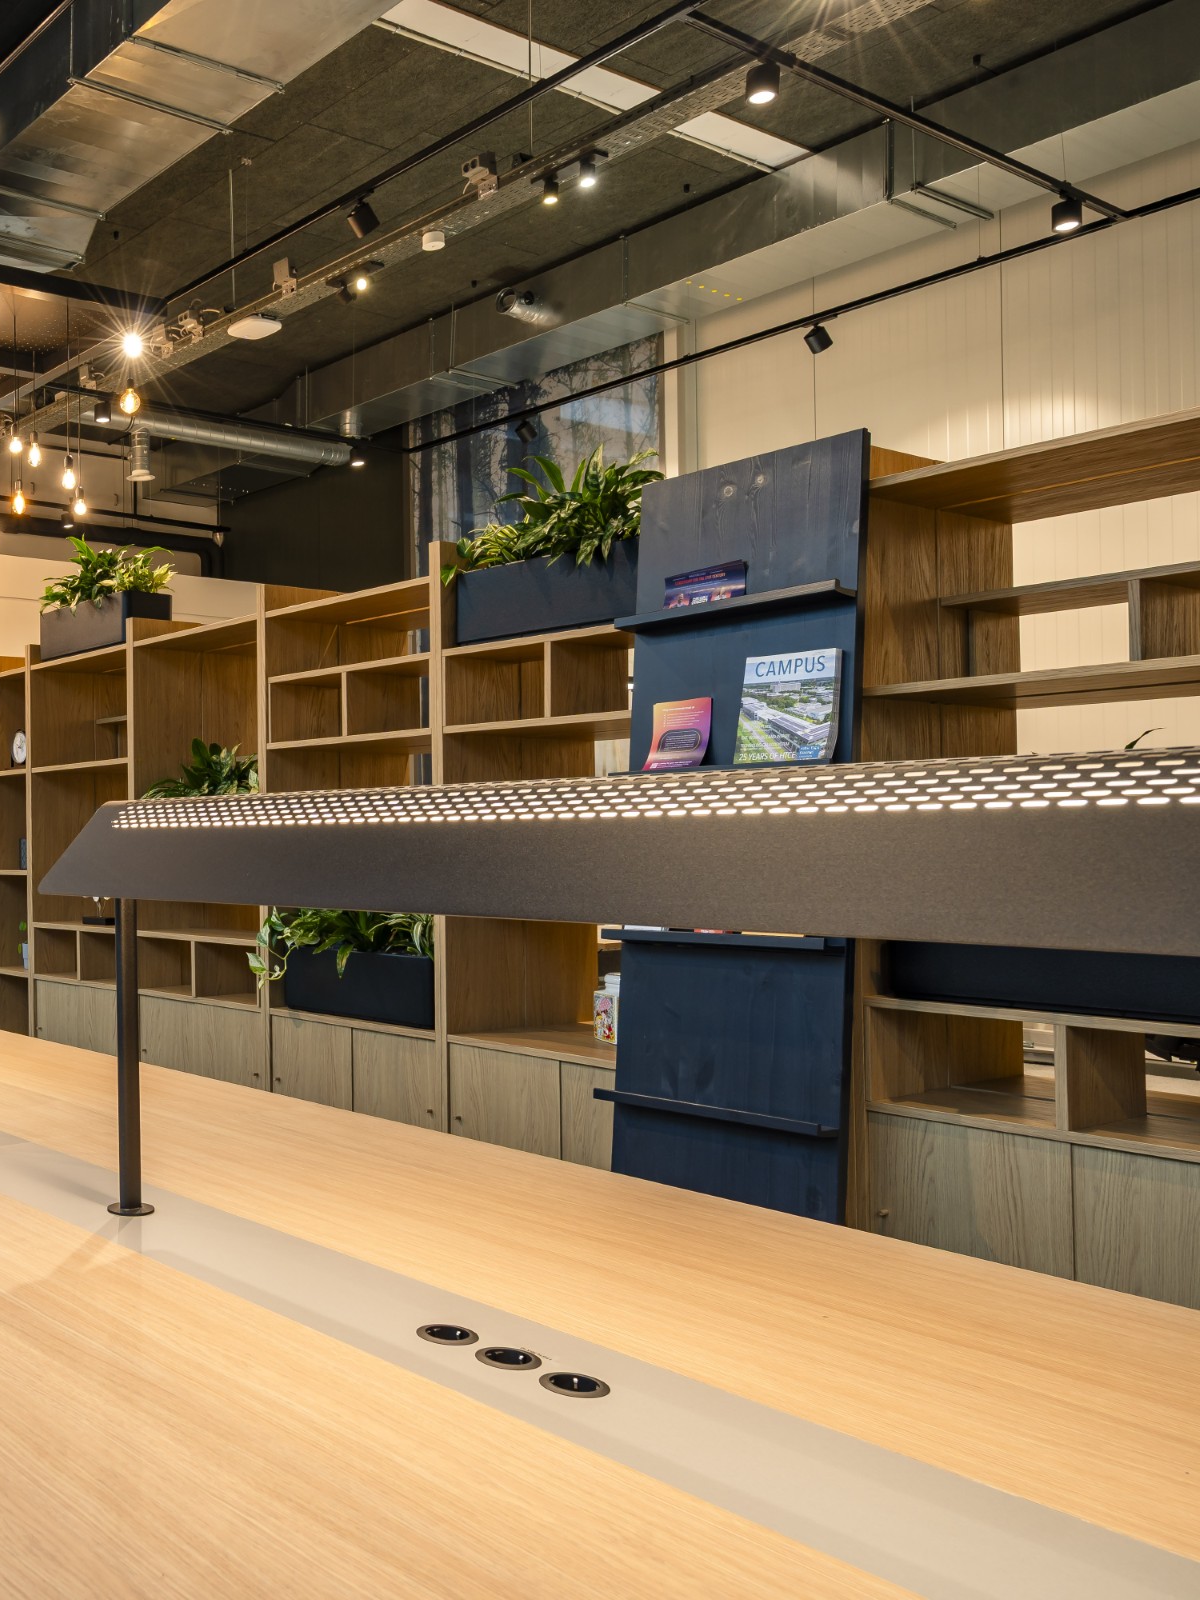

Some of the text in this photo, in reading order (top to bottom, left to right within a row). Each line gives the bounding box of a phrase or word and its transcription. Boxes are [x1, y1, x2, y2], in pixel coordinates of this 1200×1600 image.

[755, 655, 826, 677] CAMPUS
[738, 753, 748, 761] 25
[749, 752, 768, 760] YEARS
[769, 752, 779, 760] OF
